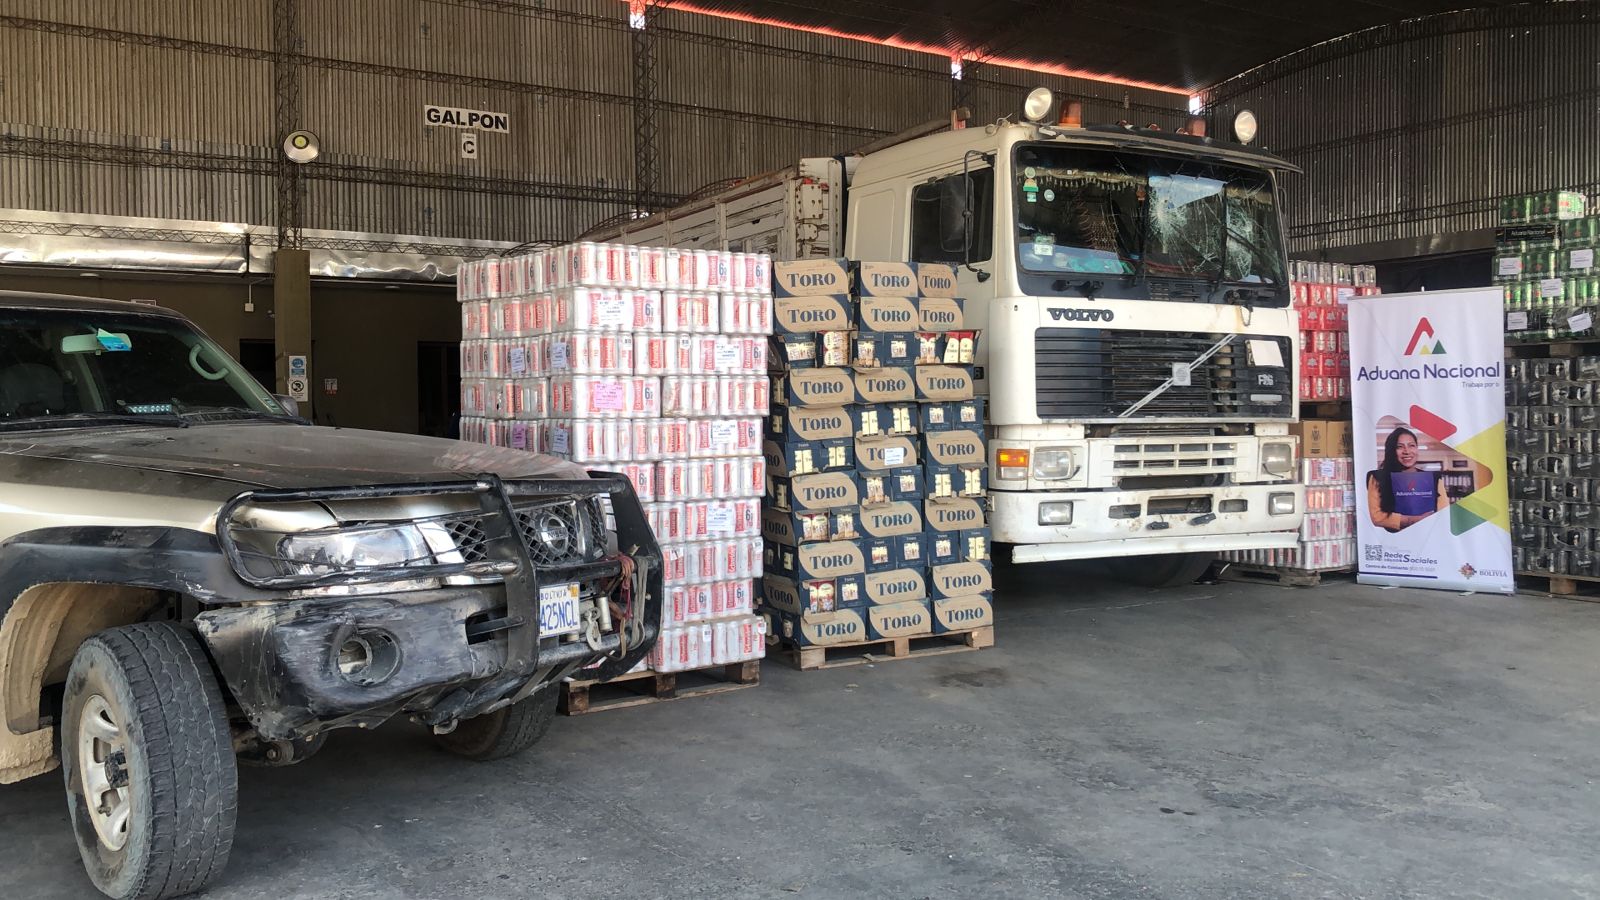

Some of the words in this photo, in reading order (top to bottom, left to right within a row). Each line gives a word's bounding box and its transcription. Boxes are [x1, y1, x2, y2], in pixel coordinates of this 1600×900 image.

[427, 108, 508, 130] GALPON
[463, 140, 474, 154] C
[719, 263, 724, 275] 6
[756, 265, 760, 277] 6
[787, 273, 836, 287] TORO
[872, 273, 910, 287] TORO
[922, 276, 951, 289] TORO
[645, 304, 650, 315] 6
[788, 308, 836, 323] TORO
[871, 308, 911, 322] TORO
[922, 309, 955, 323] TORO
[1047, 308, 1114, 322] VOLVO
[754, 347, 758, 358] 6
[1358, 366, 1420, 381] Aduana
[1424, 361, 1500, 379] Nacional
[800, 381, 843, 395] TORO
[866, 379, 906, 392] TORO
[927, 377, 965, 390] TORO
[645, 387, 650, 399] 6
[799, 417, 841, 431] TORO
[748, 427, 753, 438] 6
[867, 447, 908, 462] TO
[936, 443, 975, 456] TORO
[639, 473, 644, 485] 6
[803, 486, 847, 501] TORO
[746, 510, 750, 521] 6
[872, 513, 912, 528] TORO
[936, 509, 975, 522] TORO
[810, 554, 853, 569] TORO
[1403, 554, 1438, 564] Sociales
[876, 580, 917, 595] TORO
[942, 574, 982, 589] TORO
[699, 592, 704, 602] 6
[737, 588, 741, 598] 6
[769, 587, 793, 605] TORO
[880, 614, 922, 629] TORO
[945, 607, 984, 622] TORO
[814, 623, 856, 637] TORO
